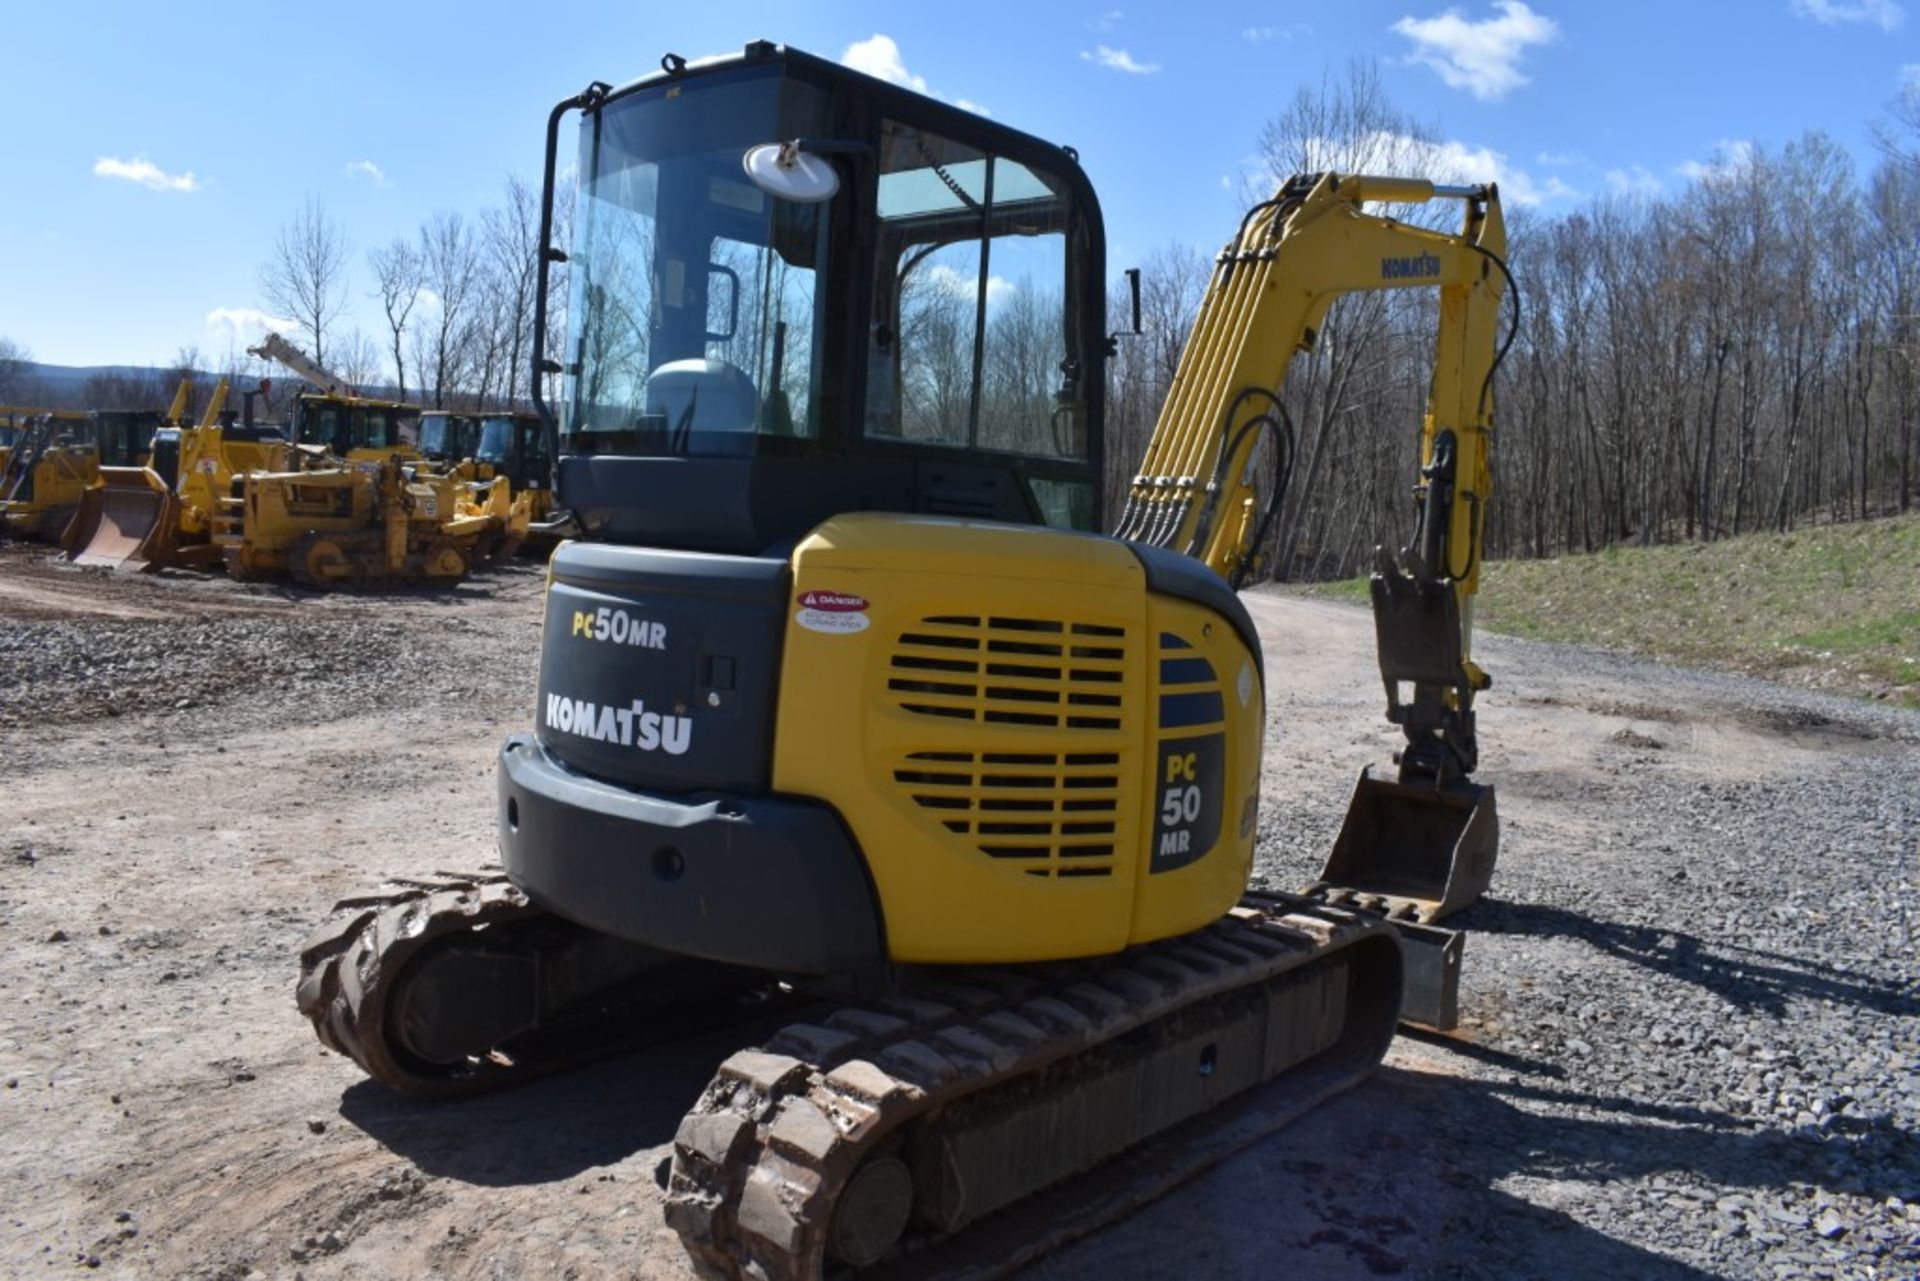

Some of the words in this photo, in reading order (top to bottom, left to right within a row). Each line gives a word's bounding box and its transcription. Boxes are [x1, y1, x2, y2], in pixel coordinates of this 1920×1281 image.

[1381, 249, 1440, 278] KOMATSU
[819, 595, 864, 605] DANGER
[573, 607, 666, 649] PC50MR
[546, 693, 692, 755] KOMATSU
[1166, 753, 1196, 783] PC
[1162, 784, 1201, 826] 50
[1159, 830, 1190, 855] MR
